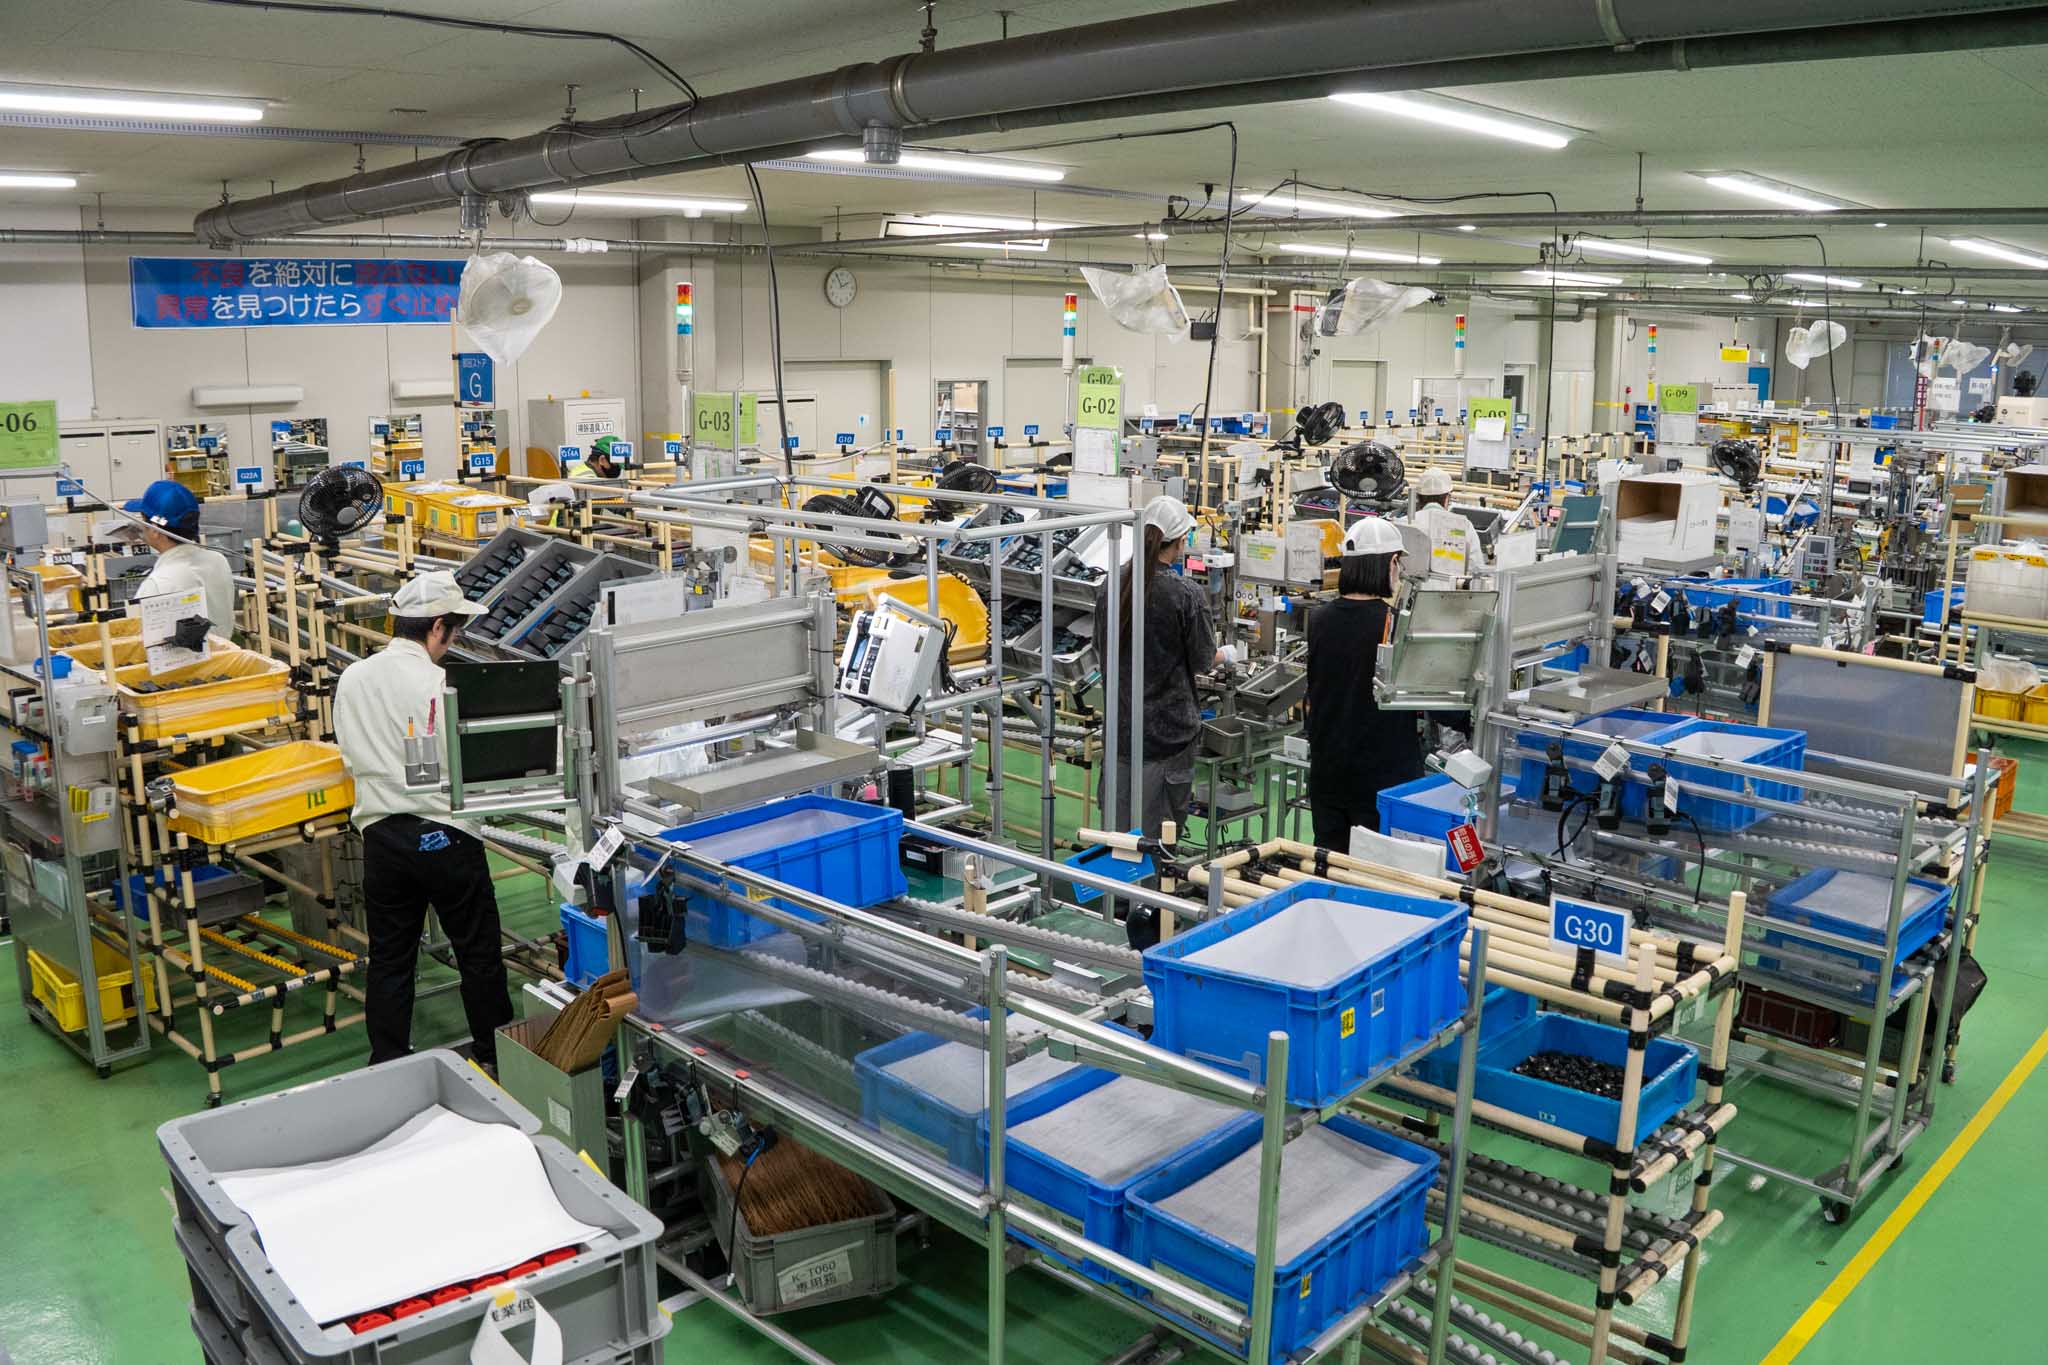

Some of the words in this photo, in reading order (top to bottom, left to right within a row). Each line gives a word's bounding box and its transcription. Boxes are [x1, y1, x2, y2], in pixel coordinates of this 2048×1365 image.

[469, 372, 482, 398] G
[1082, 397, 1115, 415] G-02
[698, 410, 730, 432] G-03
[474, 457, 491, 466] G15
[1564, 915, 1613, 946] G30
